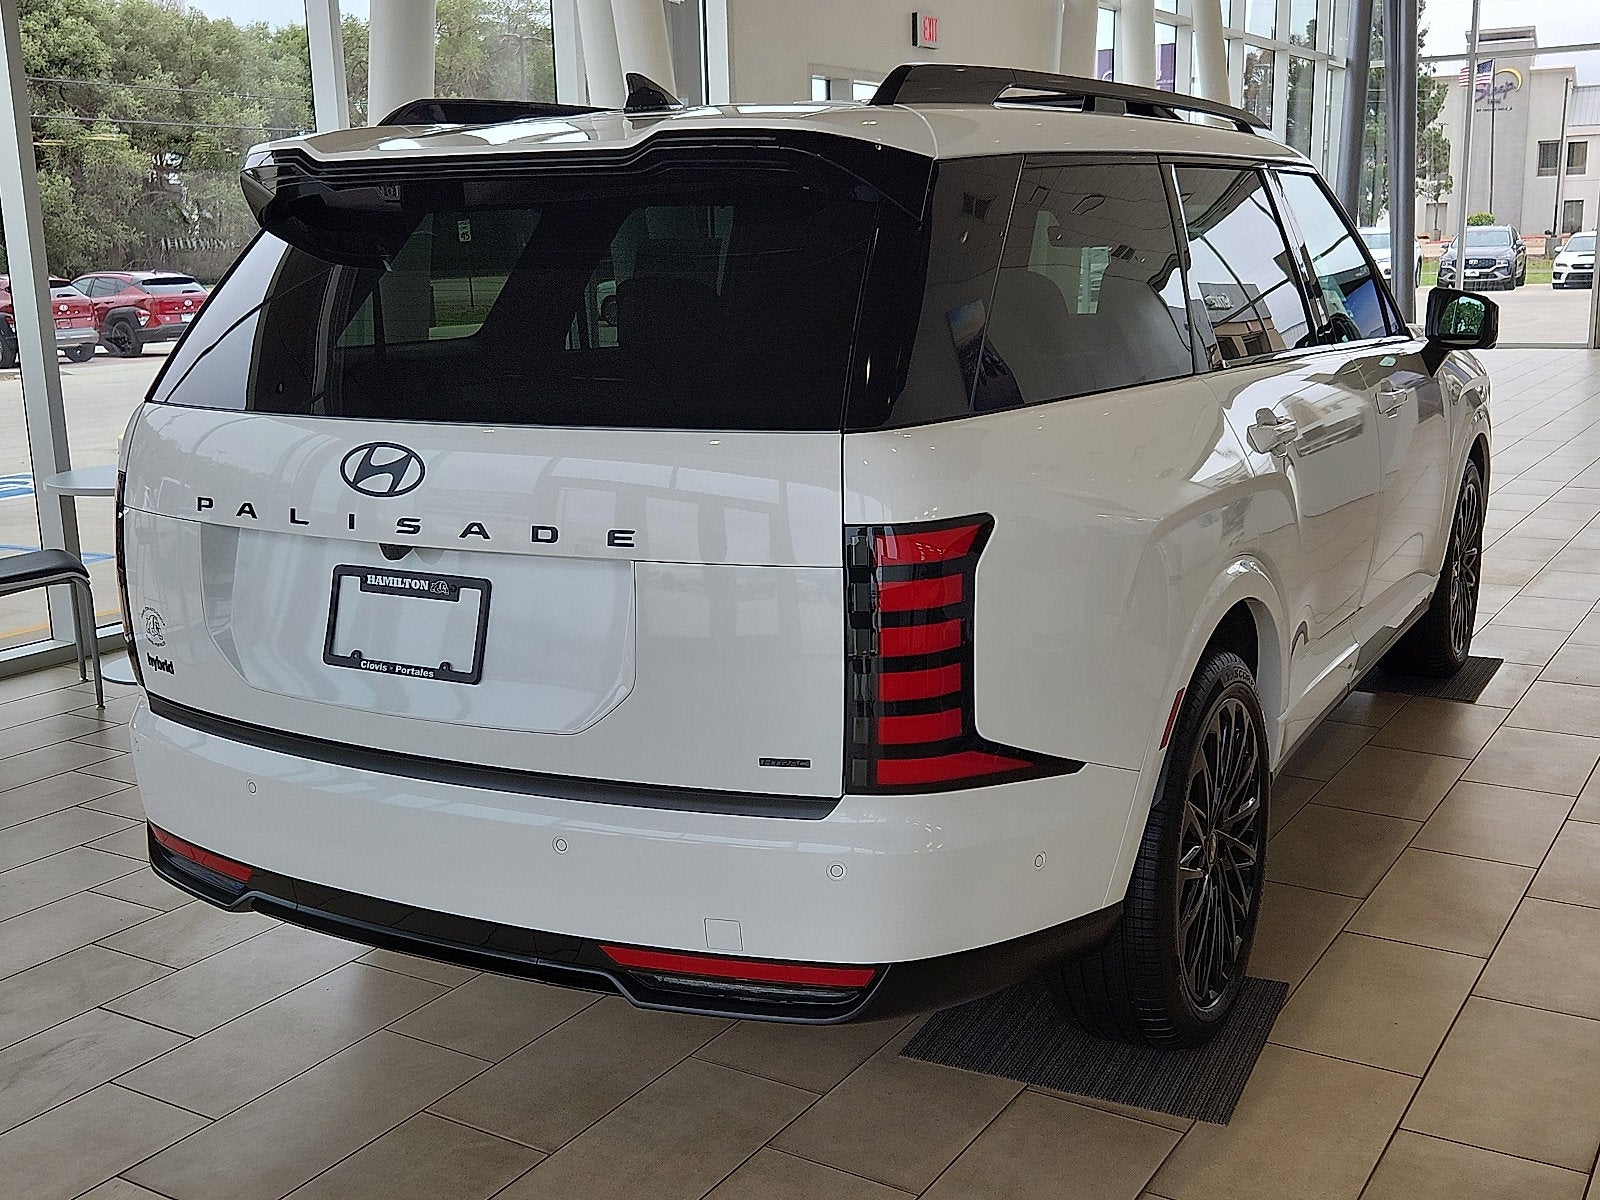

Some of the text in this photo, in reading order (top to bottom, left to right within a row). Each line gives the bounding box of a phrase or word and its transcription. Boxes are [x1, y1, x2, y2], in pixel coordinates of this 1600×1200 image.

[922, 16, 938, 42] EXIT
[196, 496, 636, 549] PALISADE
[366, 574, 430, 591] HAMILTON
[360, 660, 434, 678] Clovis Portales
